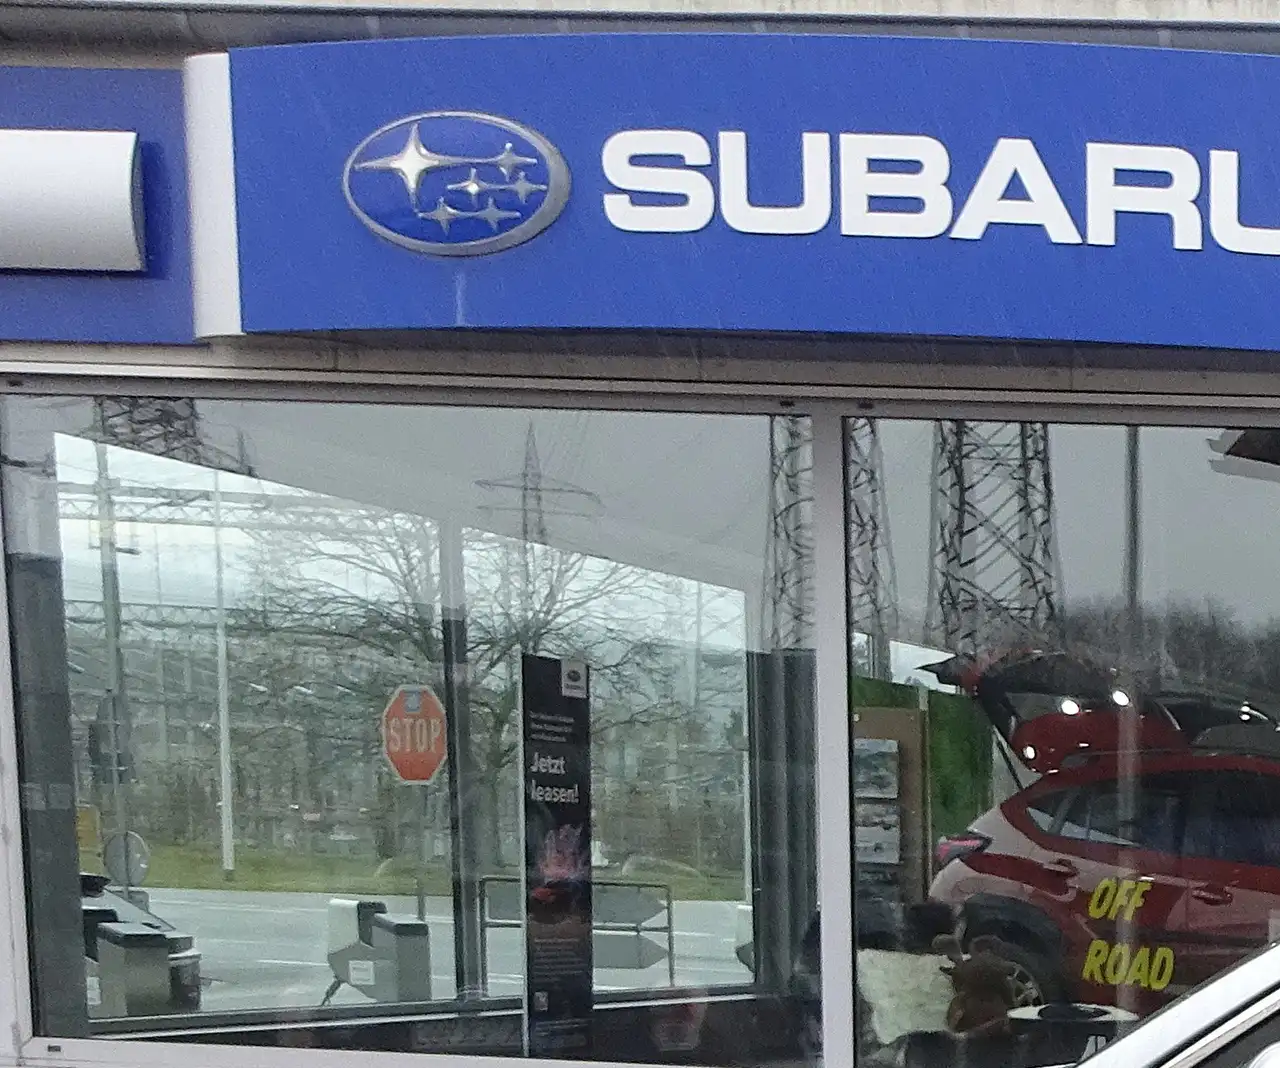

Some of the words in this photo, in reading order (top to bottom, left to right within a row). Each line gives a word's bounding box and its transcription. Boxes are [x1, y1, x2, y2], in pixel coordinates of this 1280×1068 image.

[388, 717, 442, 754] STOP
[530, 751, 567, 775] Jetzt
[530, 778, 580, 804] leasen!
[1088, 878, 1153, 921] OFF
[1082, 939, 1175, 990] ROAD
